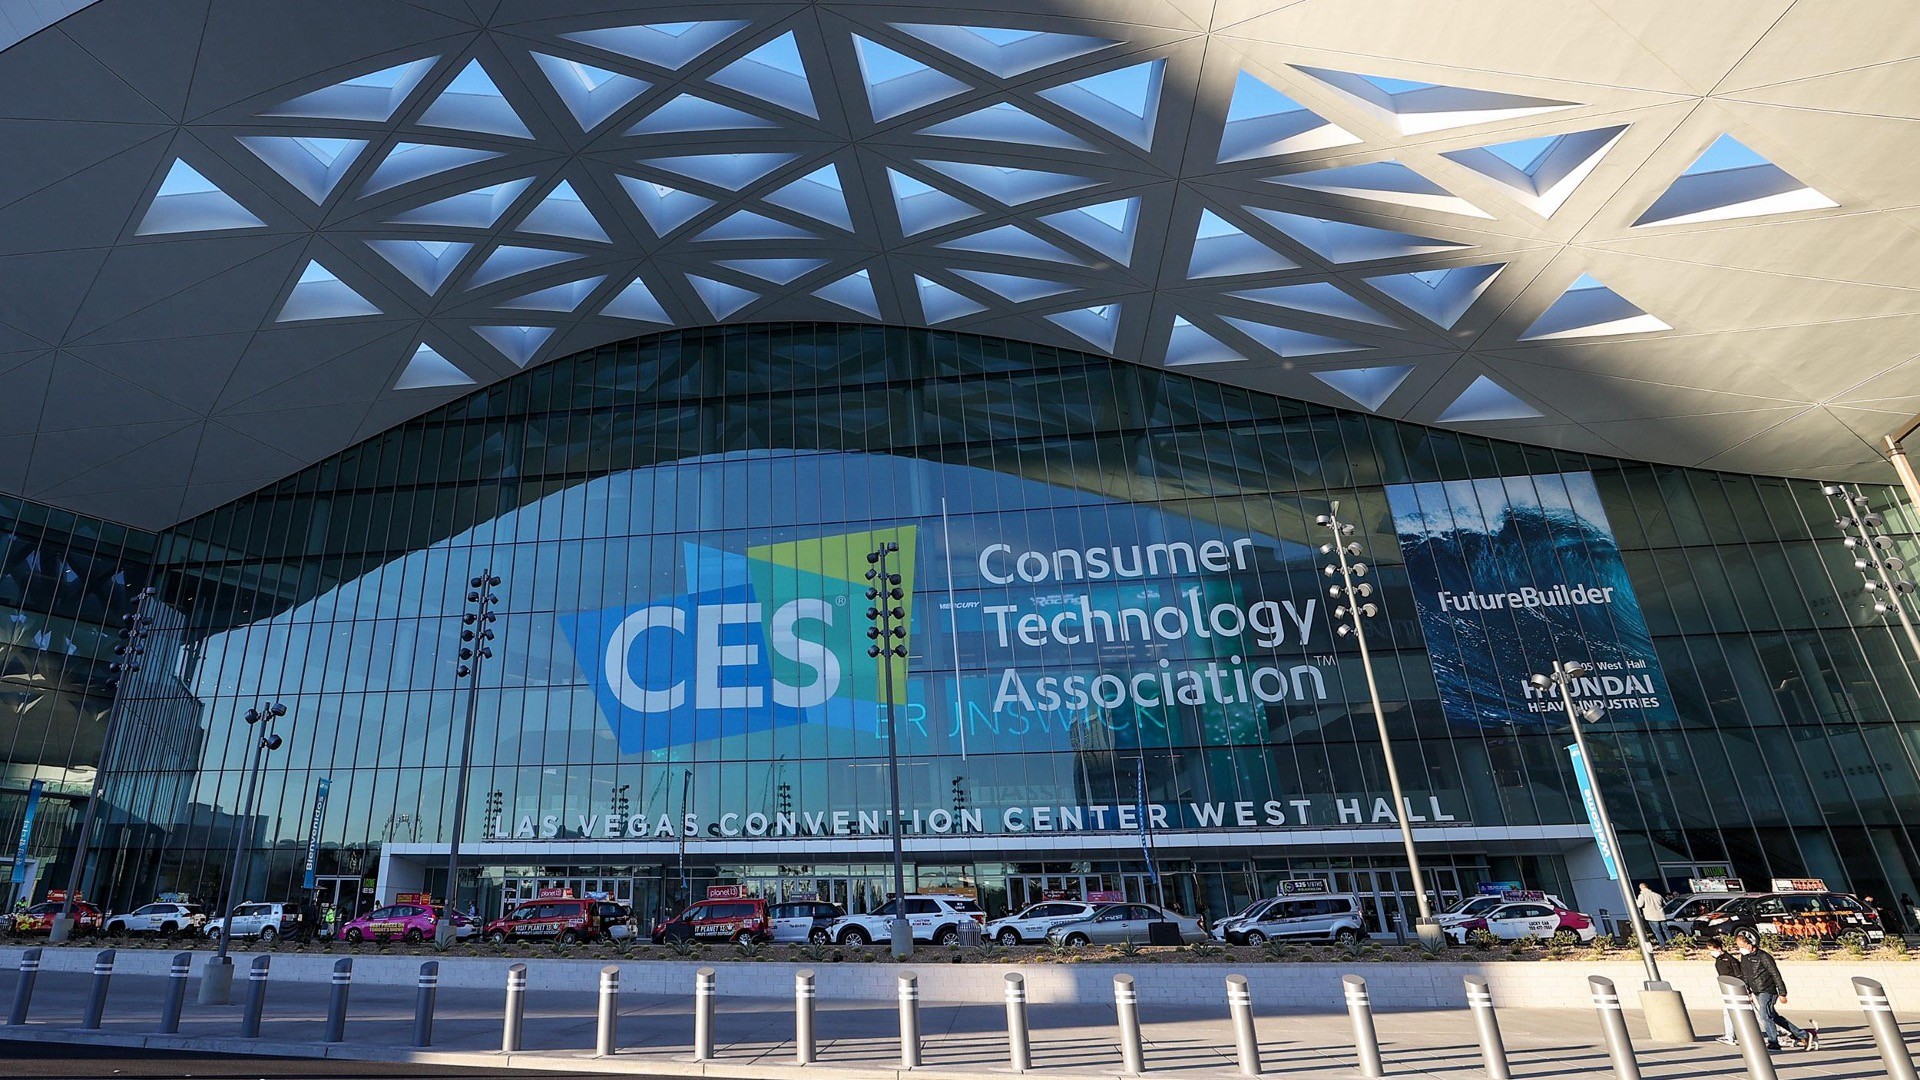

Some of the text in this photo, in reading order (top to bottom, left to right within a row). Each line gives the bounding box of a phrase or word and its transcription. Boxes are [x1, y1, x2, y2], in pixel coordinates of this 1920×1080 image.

[979, 537, 1252, 585] Consumer
[983, 589, 1316, 648] Technology
[1438, 583, 1614, 612] FutureBuilder
[604, 597, 841, 713] CES
[992, 655, 1328, 713] Association
[1597, 660, 1623, 671] West
[1626, 659, 1646, 669] Hall
[305, 796, 324, 870] Bienvenidos
[494, 814, 559, 838] LAS
[578, 813, 700, 837] VEGAS
[720, 808, 983, 836] CONVENTION
[1003, 804, 1170, 831] CENTER
[1190, 799, 1312, 827] WEST
[1335, 796, 1455, 824] HALL
[1584, 788, 1611, 857] Welcome
